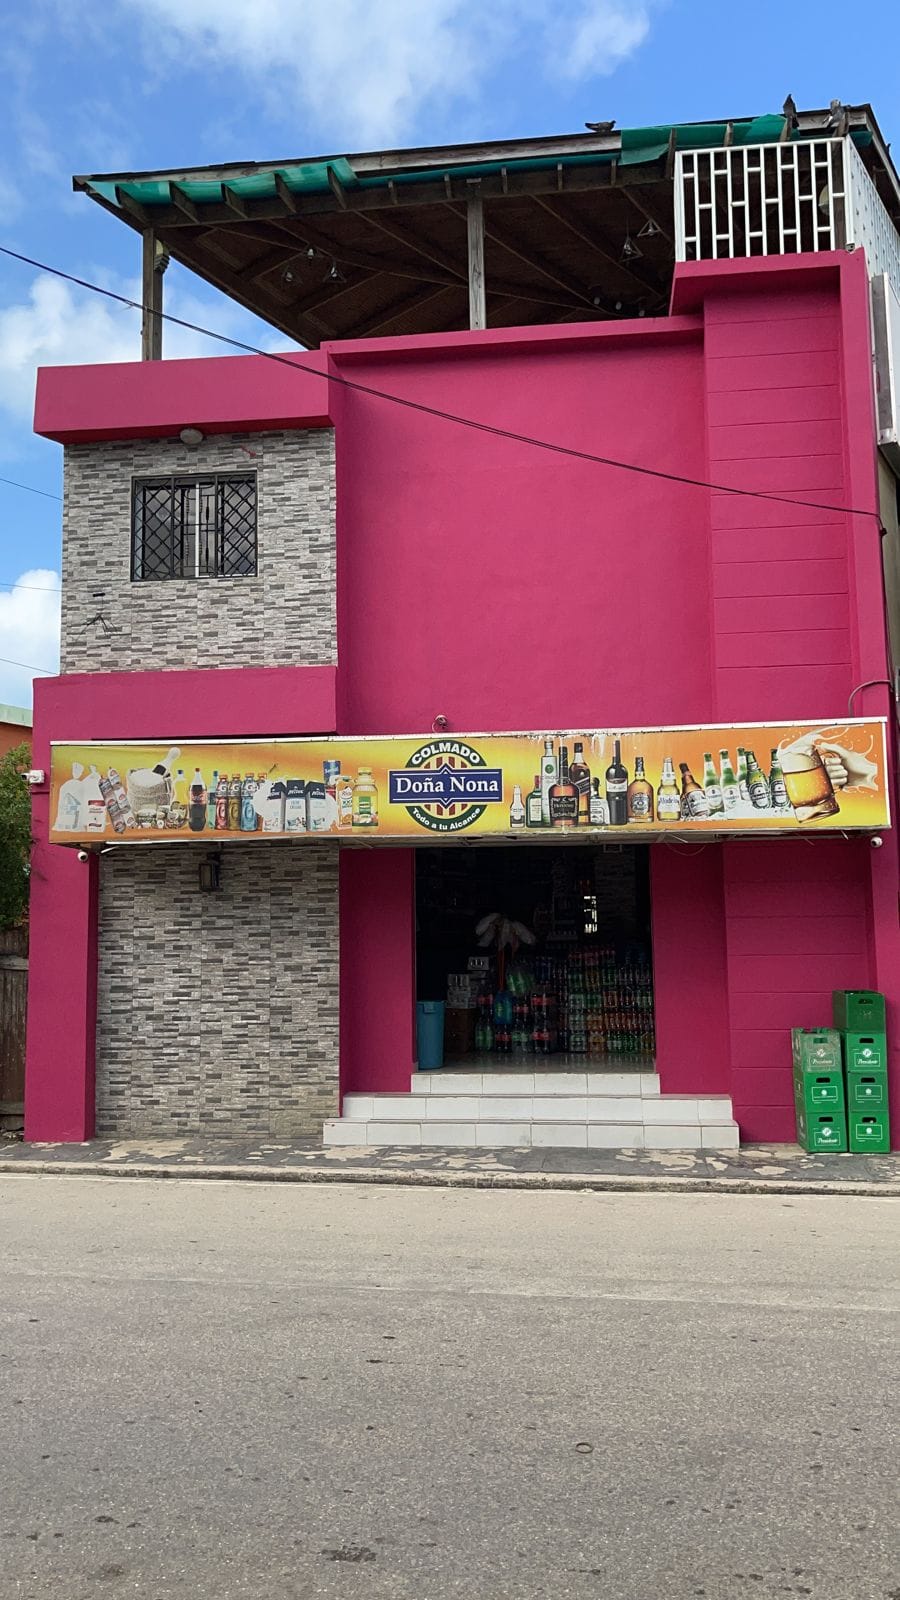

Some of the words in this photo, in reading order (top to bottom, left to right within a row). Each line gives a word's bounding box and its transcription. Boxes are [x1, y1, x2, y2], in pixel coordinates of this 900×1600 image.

[411, 742, 481, 765] COLMADO
[396, 777, 445, 793] Doña
[449, 776, 499, 792] Nona
[412, 807, 430, 826] Todo
[449, 807, 481, 830] Alcance
